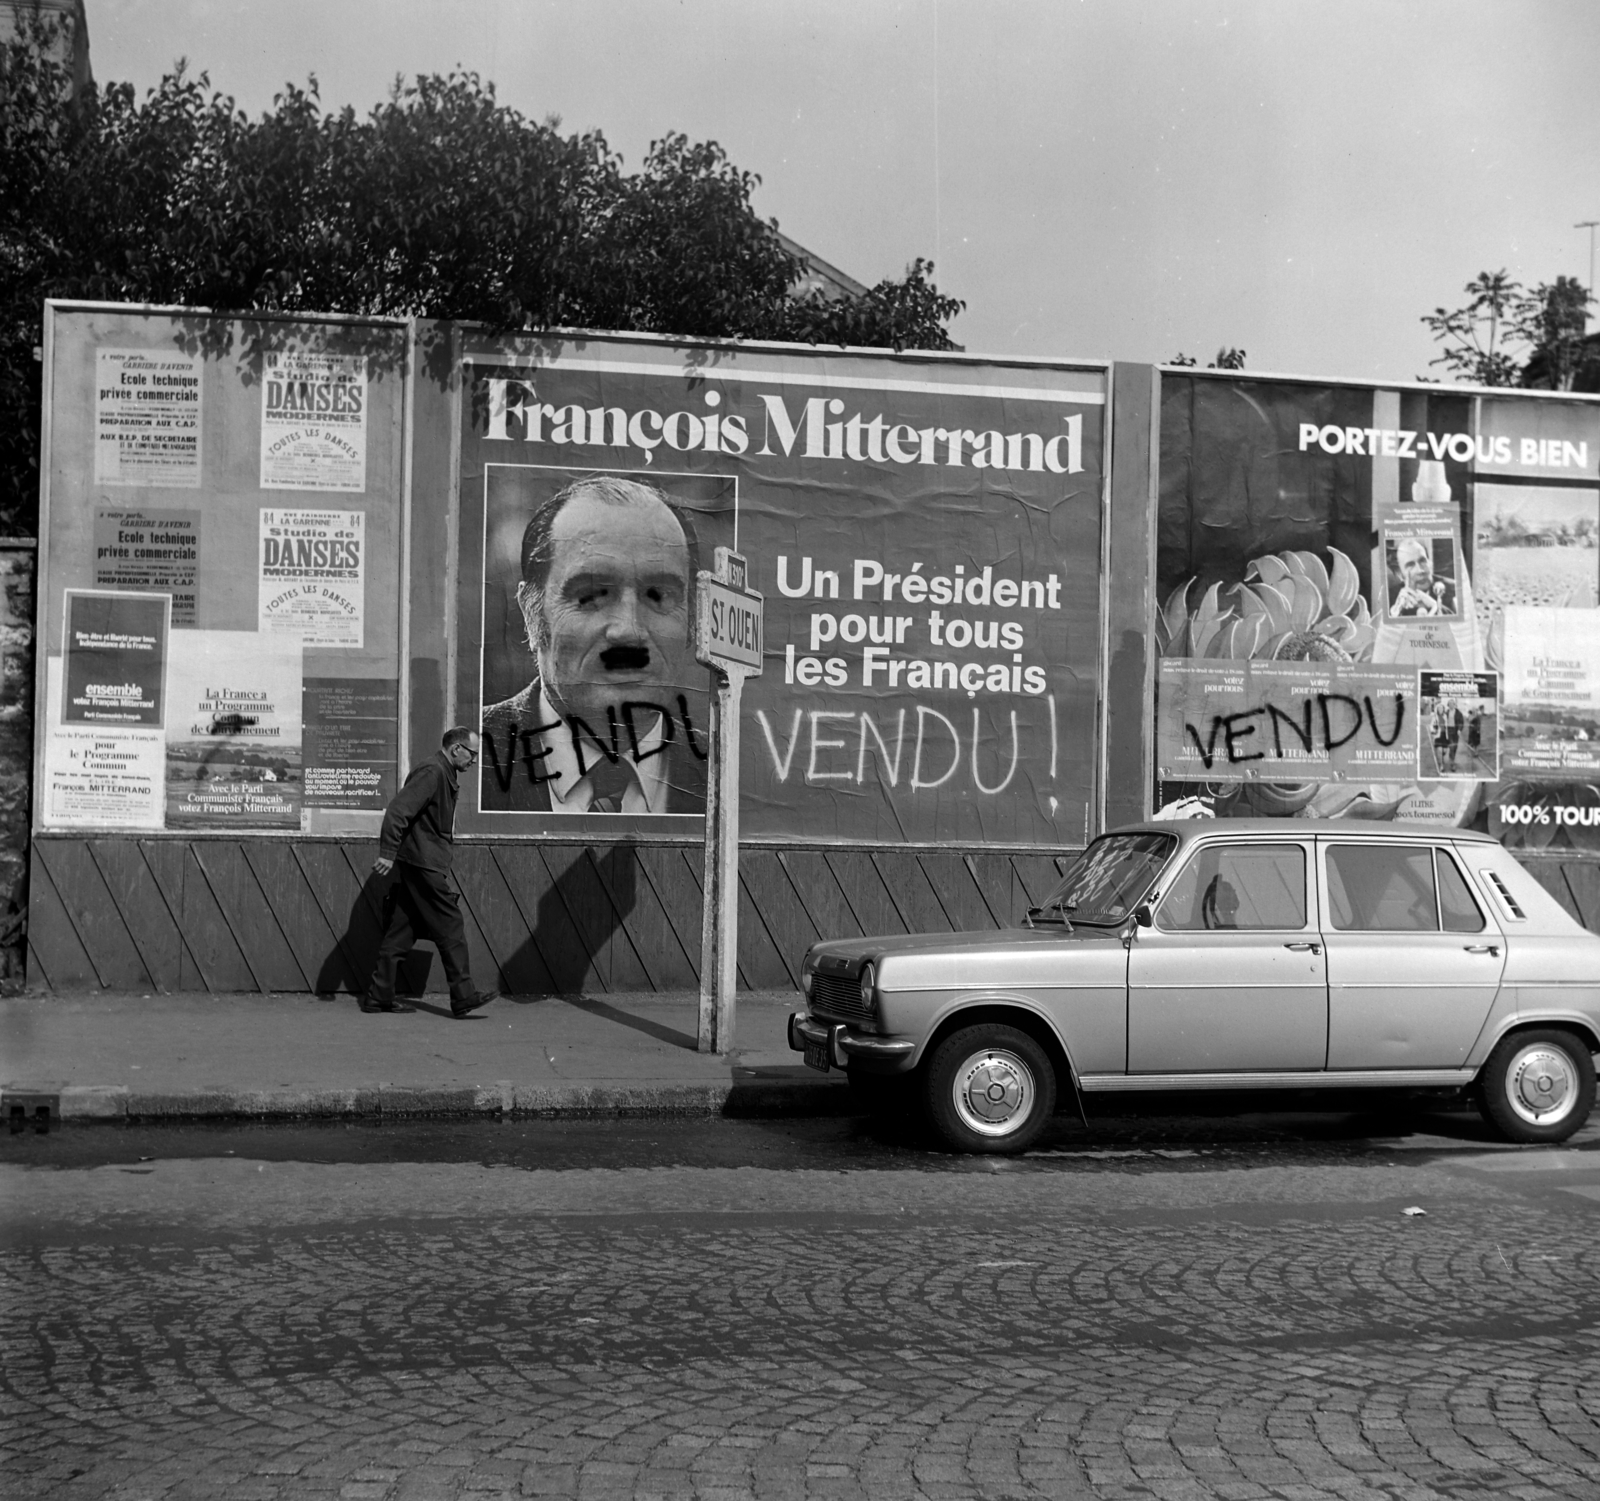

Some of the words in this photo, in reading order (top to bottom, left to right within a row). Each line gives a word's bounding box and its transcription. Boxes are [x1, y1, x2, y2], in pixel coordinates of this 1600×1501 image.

[121, 372, 147, 386] Ecole
[152, 374, 198, 388] technique
[273, 370, 331, 382] Studio
[337, 374, 358, 383] de
[100, 387, 132, 401] privée
[137, 389, 198, 402] commerciale
[266, 381, 362, 413] DANSES
[266, 411, 362, 423] MODERNES
[482, 378, 749, 466] François
[755, 393, 1085, 475] Mitterrand
[268, 431, 301, 455] TOUTES
[304, 428, 320, 437] LES
[324, 432, 359, 459] DANSES
[1299, 422, 1512, 463] PORTEZ-VOUS
[1519, 438, 1587, 469] BIEN
[118, 530, 144, 544] Ecole
[150, 532, 197, 546] technique
[269, 527, 327, 538] Studio
[334, 530, 355, 538] de
[97, 545, 129, 559] privée
[134, 547, 197, 560] commerciale
[263, 538, 360, 569] DANSES
[263, 568, 360, 578] MODERNES
[776, 555, 840, 599] Un
[853, 559, 1062, 609] Président
[266, 588, 299, 613] TOUTES
[302, 585, 317, 594] LES
[322, 588, 356, 615] DANSES
[728, 604, 759, 653] OUEN
[810, 612, 913, 651] pour
[928, 610, 1024, 650] tous
[785, 643, 848, 686] les
[862, 646, 1047, 699] Français
[86, 683, 142, 697] ensemble
[206, 688, 219, 699] La
[222, 689, 259, 699] France
[198, 702, 212, 711] un
[215, 701, 275, 712] Programme
[190, 724, 203, 735] de
[1186, 692, 1405, 769] VENDU
[95, 742, 117, 751] pour
[754, 704, 1018, 798] VENDU
[70, 749, 79, 759] le
[84, 750, 139, 761] Programme
[1355, 749, 1415, 760] MITTERRAND
[82, 760, 127, 770] Commun
[53, 783, 85, 792] François
[89, 784, 151, 795] MITTERRAND
[208, 784, 228, 794] Avec
[231, 784, 240, 794] le
[242, 784, 264, 795] Parti
[187, 792, 243, 803] Communiste
[245, 794, 283, 805] Français
[178, 804, 201, 813] votez
[203, 803, 241, 815] François
[244, 804, 292, 814] Mitterrand
[1500, 804, 1551, 825] 100%
